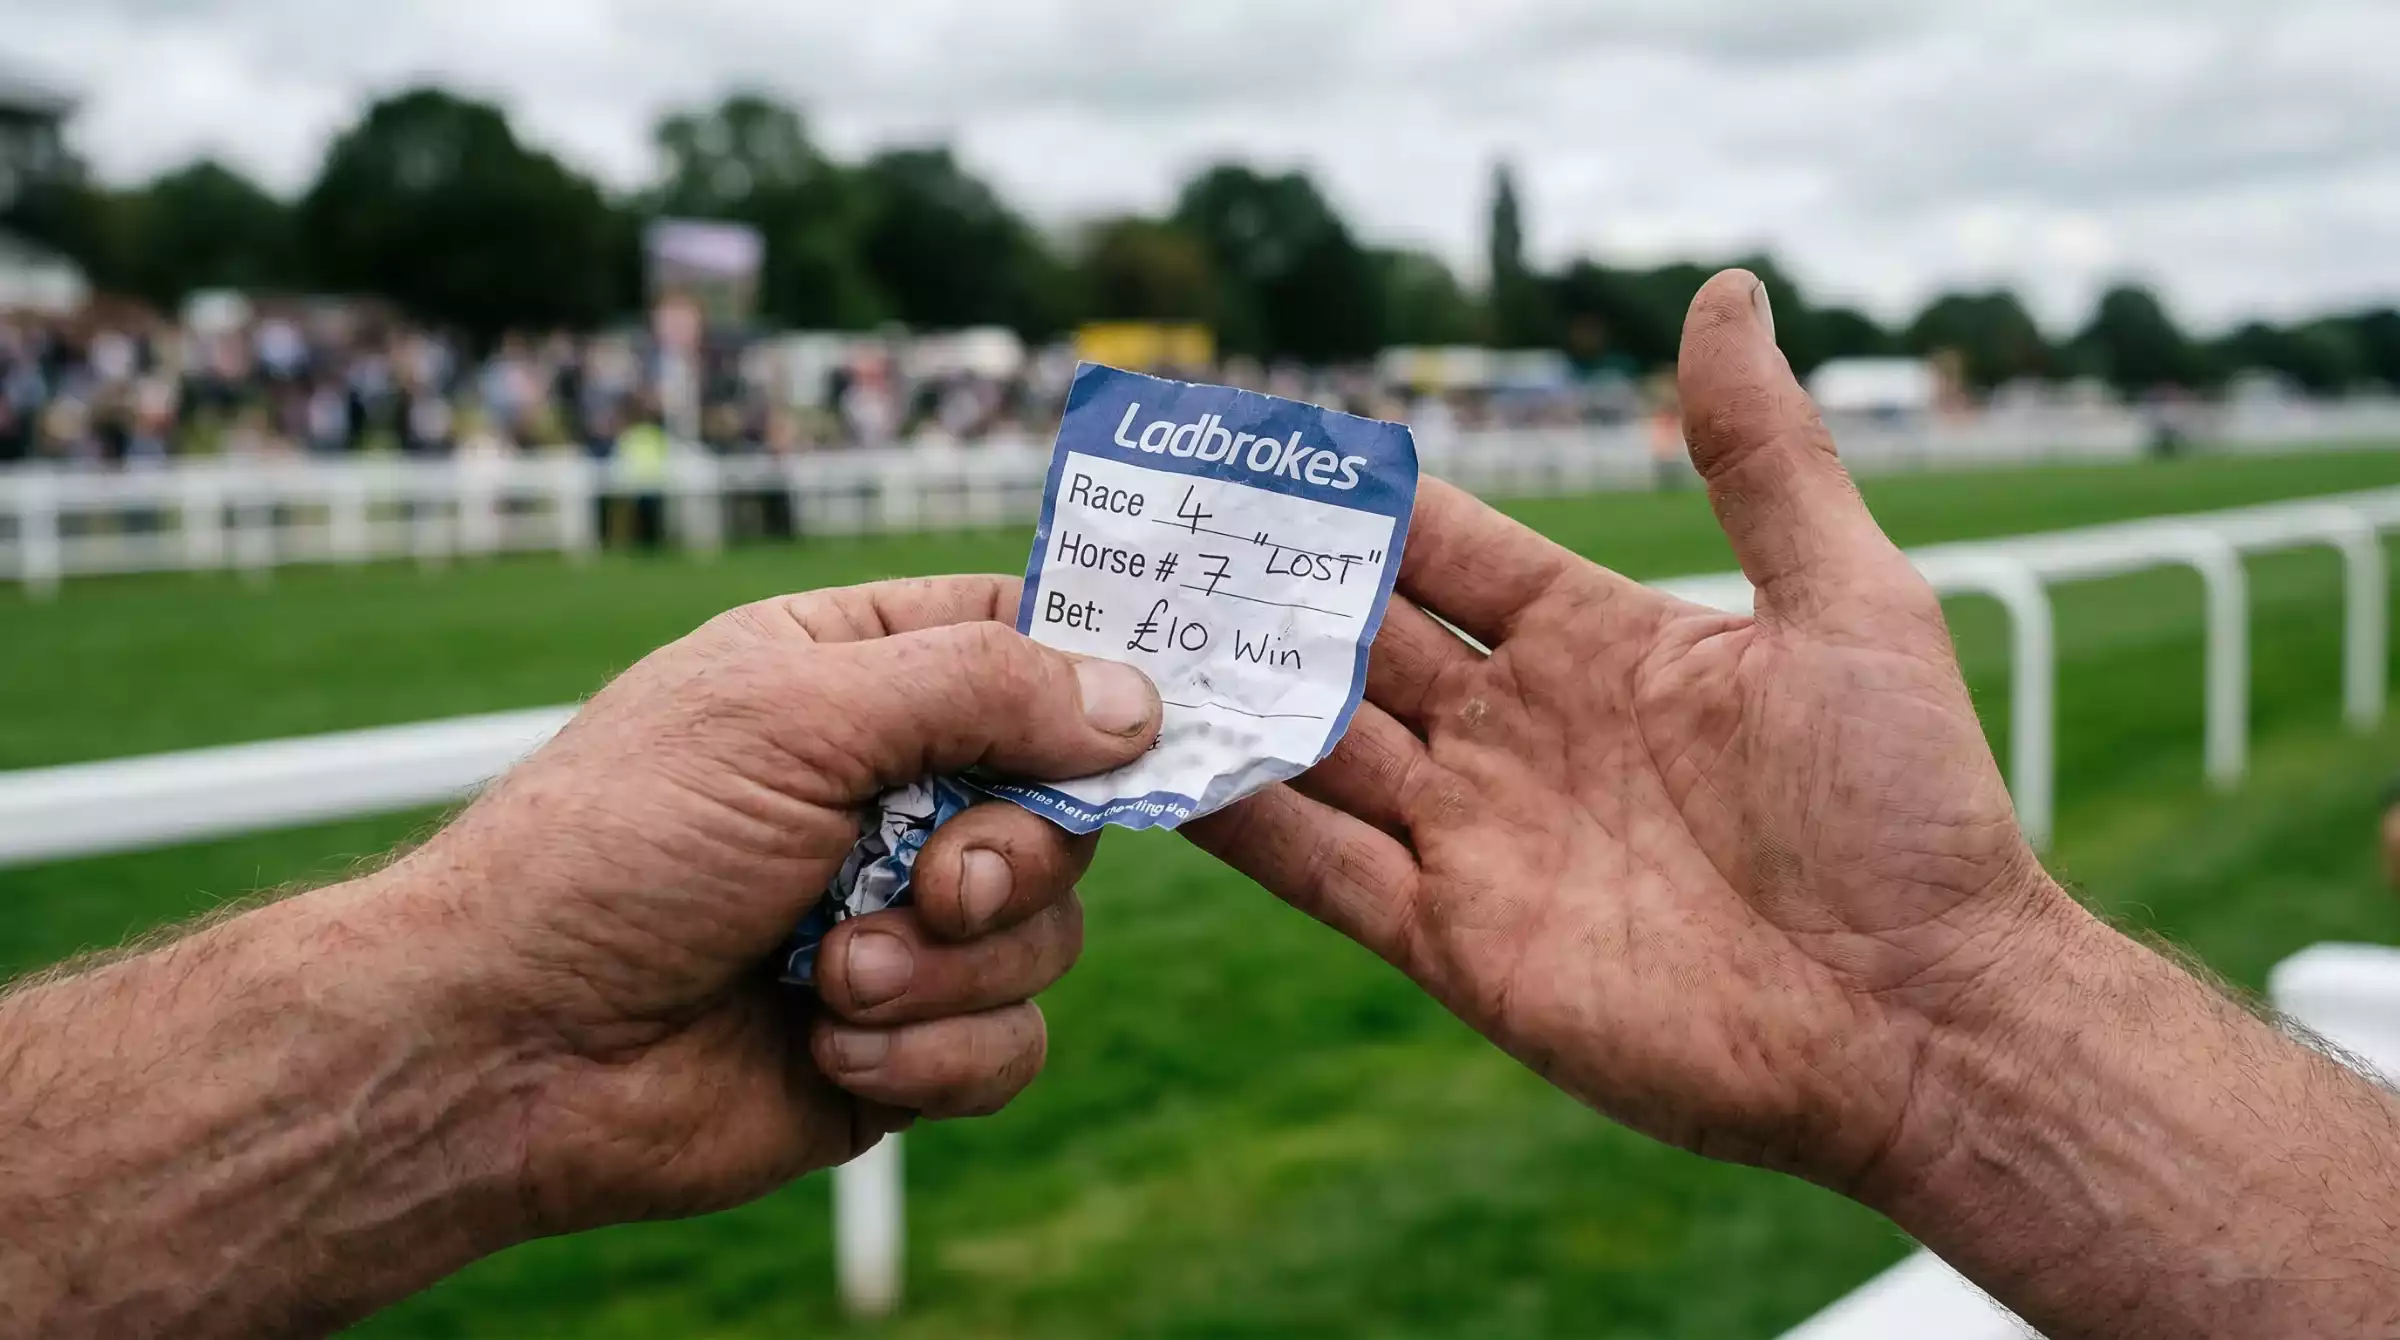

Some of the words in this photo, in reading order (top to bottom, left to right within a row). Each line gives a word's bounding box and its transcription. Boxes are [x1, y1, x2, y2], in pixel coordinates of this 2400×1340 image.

[1114, 402, 1367, 490] Ladbrokes
[1068, 473, 1145, 517] Race
[1177, 484, 1213, 535] 4
[1057, 531, 1146, 578] Horse
[1155, 552, 1179, 582] #
[1198, 553, 1231, 597] 7
[1045, 591, 1104, 633] Bet:
[1127, 599, 1209, 654] £10
[1235, 628, 1301, 670] Win
